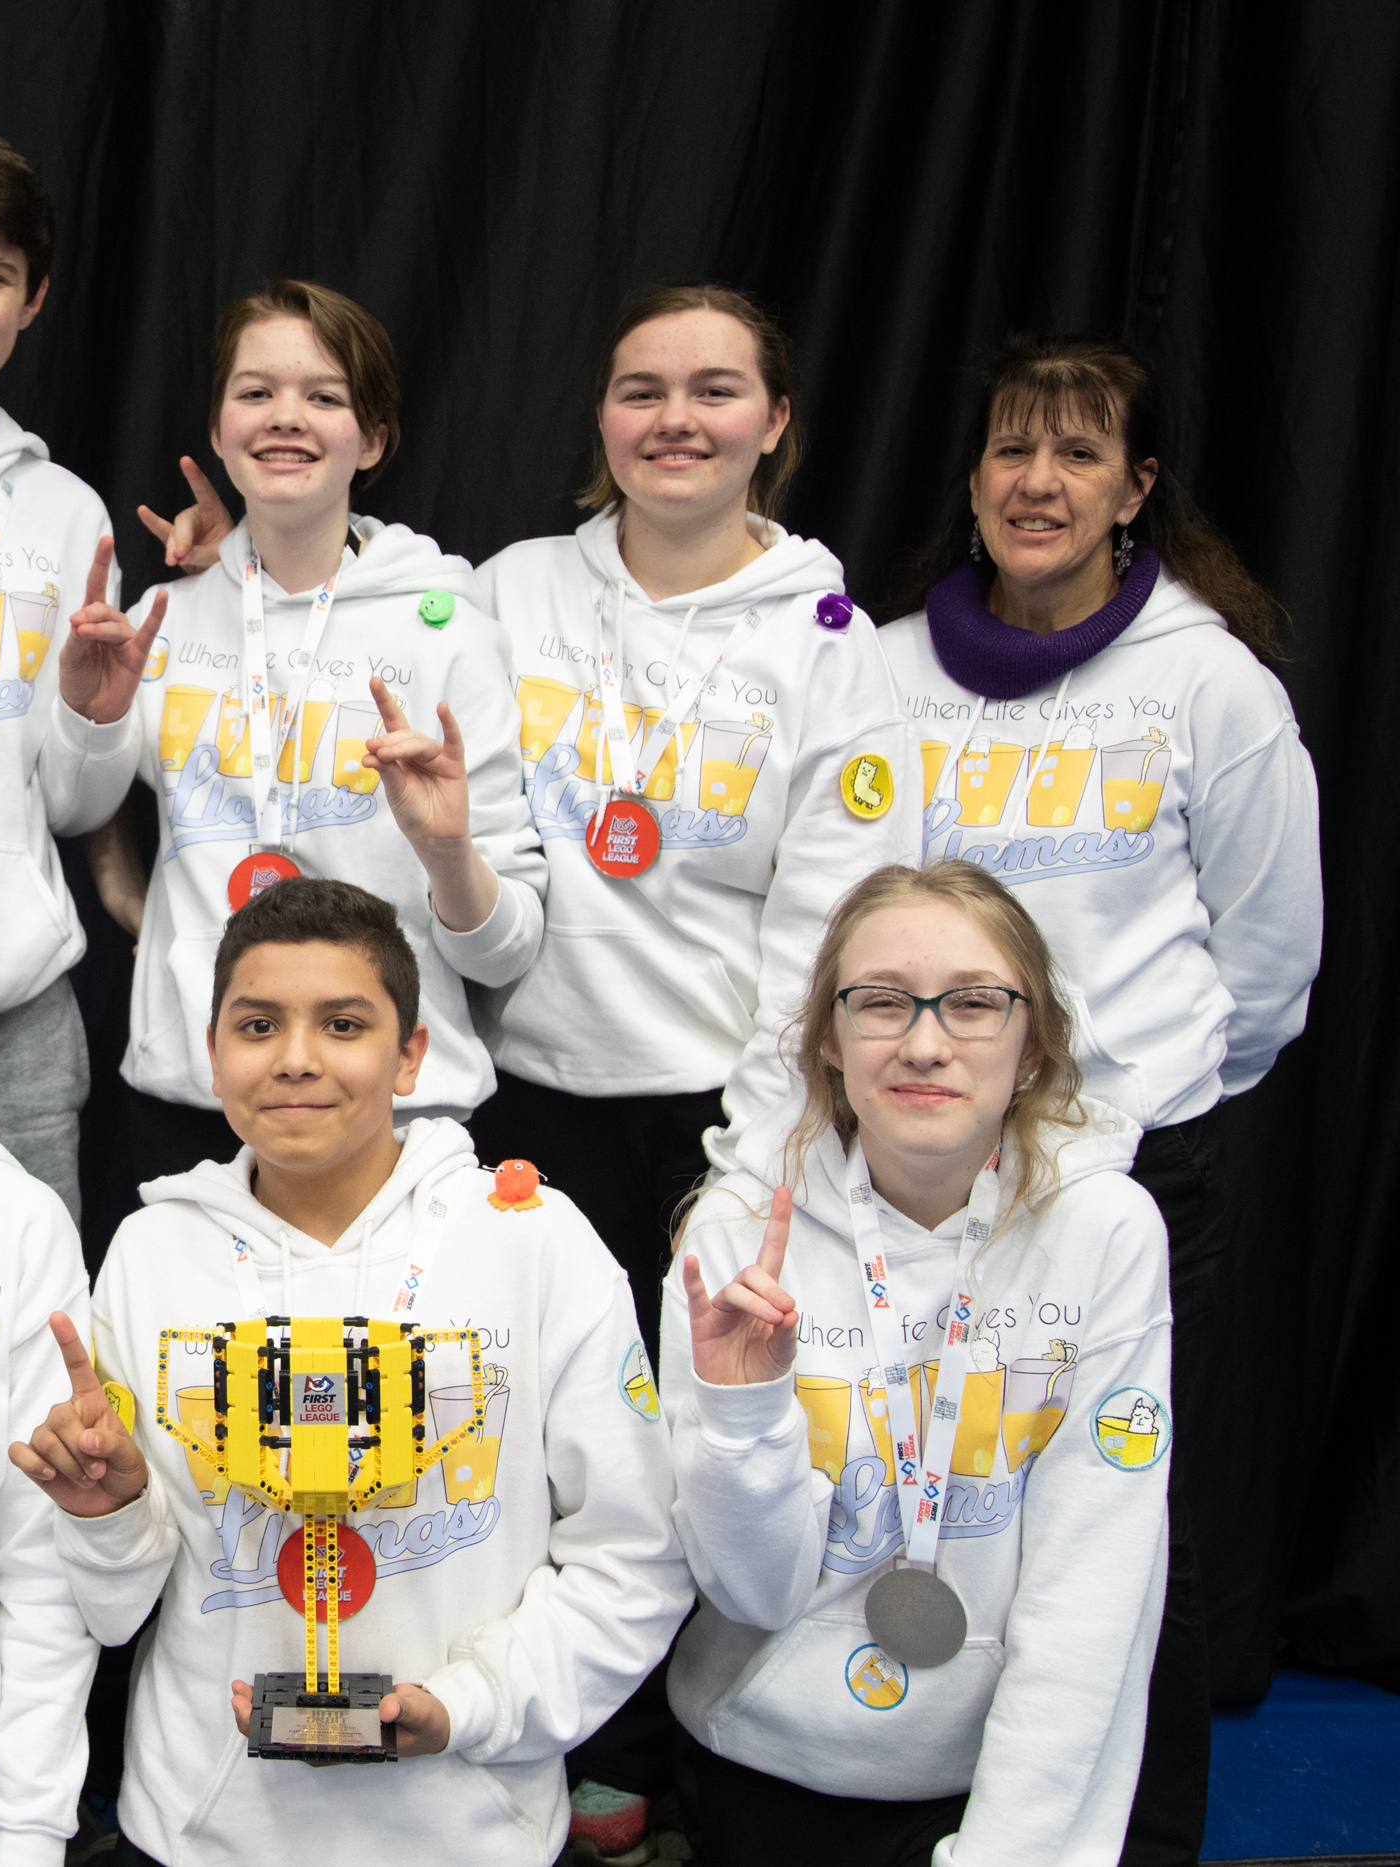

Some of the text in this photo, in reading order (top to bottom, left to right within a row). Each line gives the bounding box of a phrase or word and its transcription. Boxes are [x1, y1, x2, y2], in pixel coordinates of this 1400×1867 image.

[21, 546, 61, 575] You
[178, 641, 239, 670] When
[368, 655, 412, 685] You
[539, 634, 597, 669] When
[646, 661, 717, 697] Gvs
[731, 679, 778, 706] You
[906, 695, 1177, 721] When Life Gives You
[522, 743, 748, 841] Llaas
[606, 834, 639, 847] FIRST
[608, 844, 635, 855] LEGO
[602, 853, 640, 864] LEAGUE
[864, 1262, 873, 1282] FIRST
[876, 1254, 886, 1280] LEAGUE
[901, 1315, 928, 1343] fe
[1028, 1292, 1081, 1326] You
[947, 1320, 957, 1346] LEAGUE
[302, 1394, 336, 1404] FIRST
[305, 1404, 334, 1413] LEGO
[300, 1413, 340, 1422] LEAGUE
[917, 1497, 925, 1523] LEAGUE
[931, 1501, 939, 1521] FIRST
[315, 1566, 347, 1578] IRT
